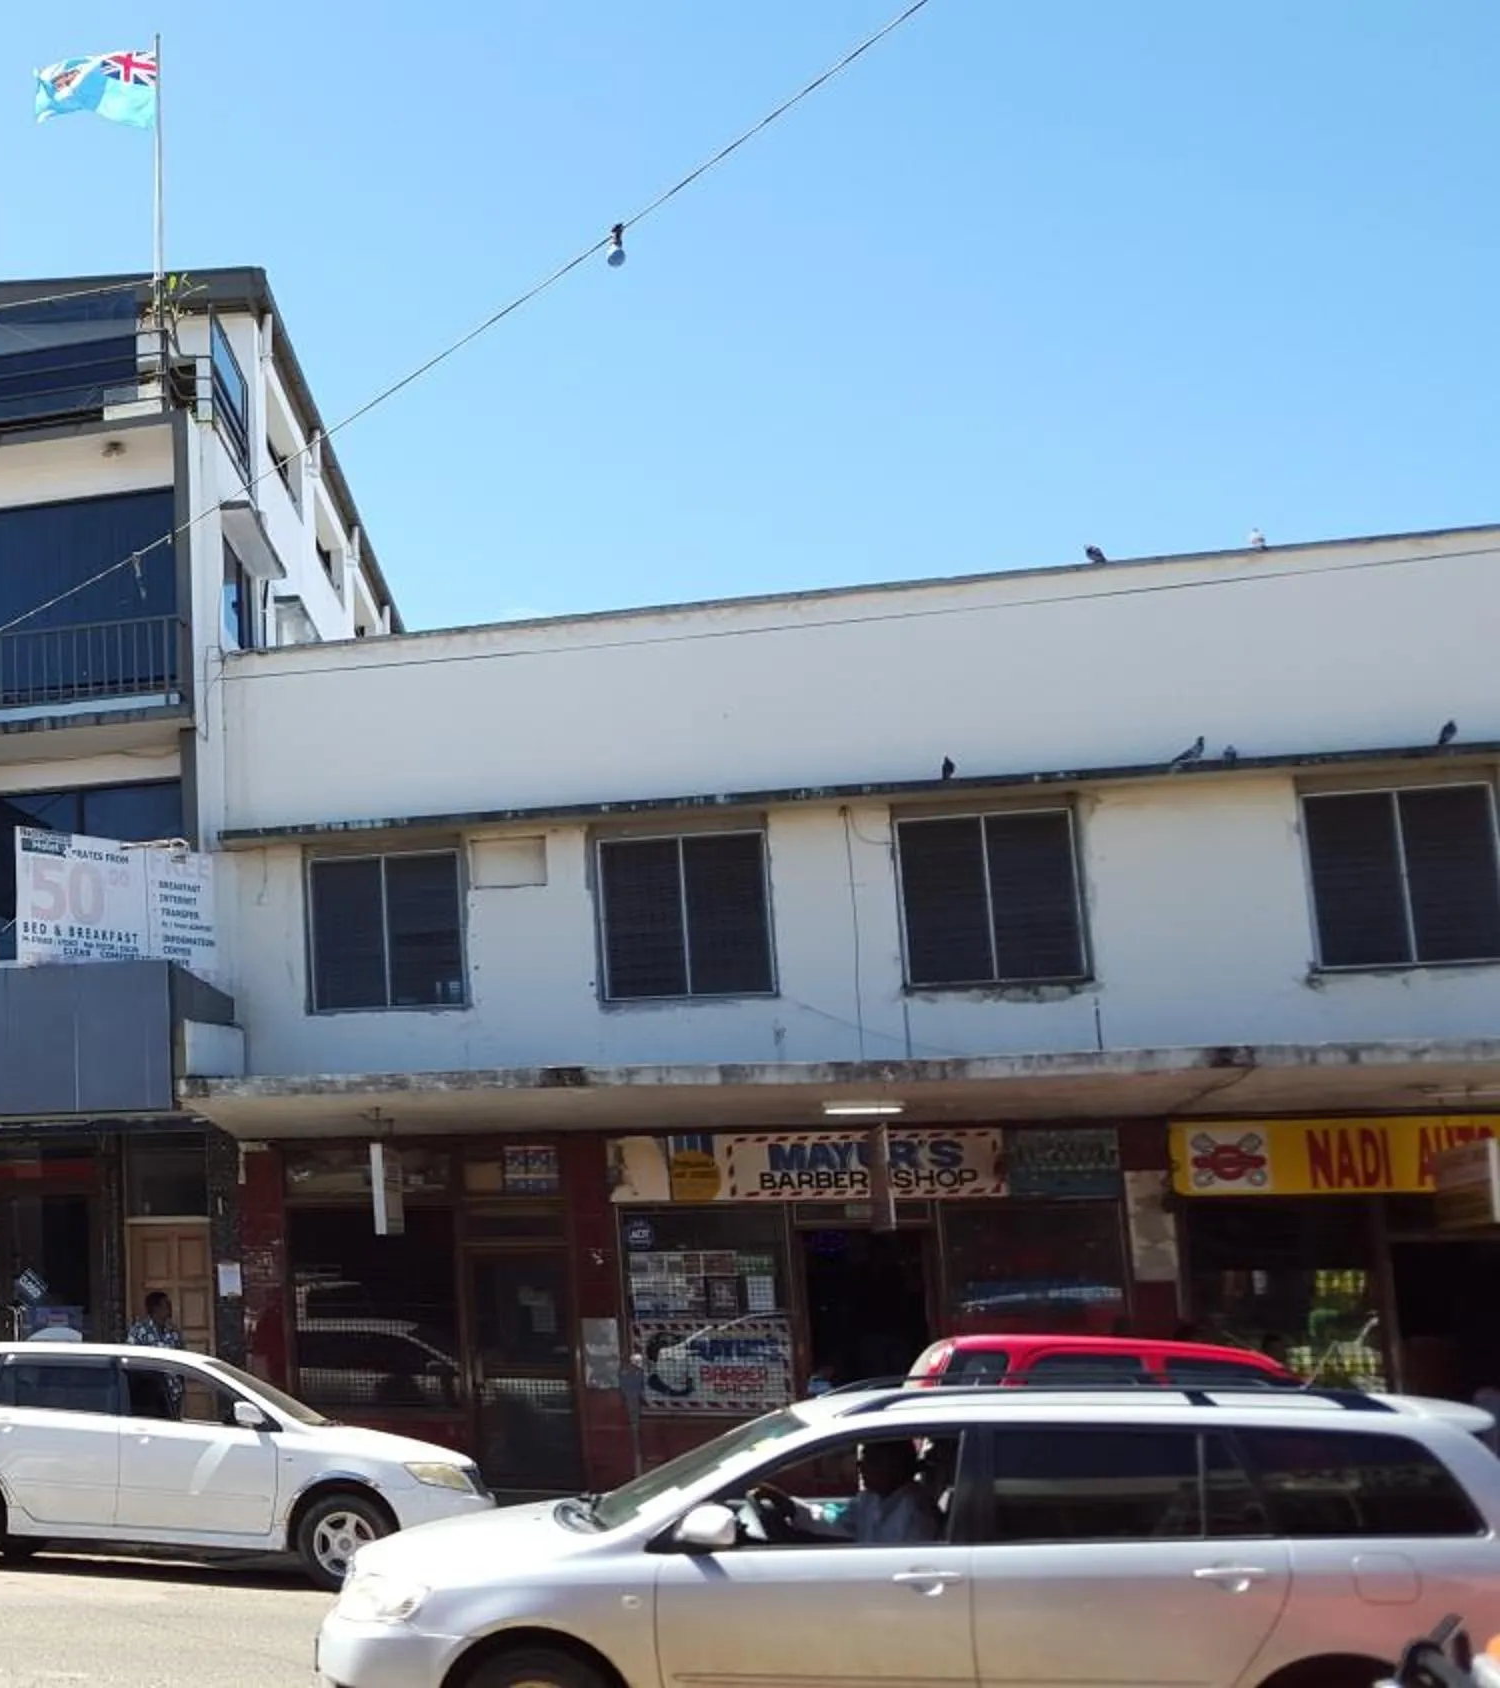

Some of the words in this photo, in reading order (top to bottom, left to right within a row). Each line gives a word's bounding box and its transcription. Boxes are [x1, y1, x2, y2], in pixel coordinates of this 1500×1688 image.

[23, 922, 47, 934] BED
[69, 926, 138, 944] BREAKFAST
[1306, 1126, 1394, 1188] NADI
[759, 1170, 868, 1190] BARBER
[893, 1168, 978, 1188] SHOP
